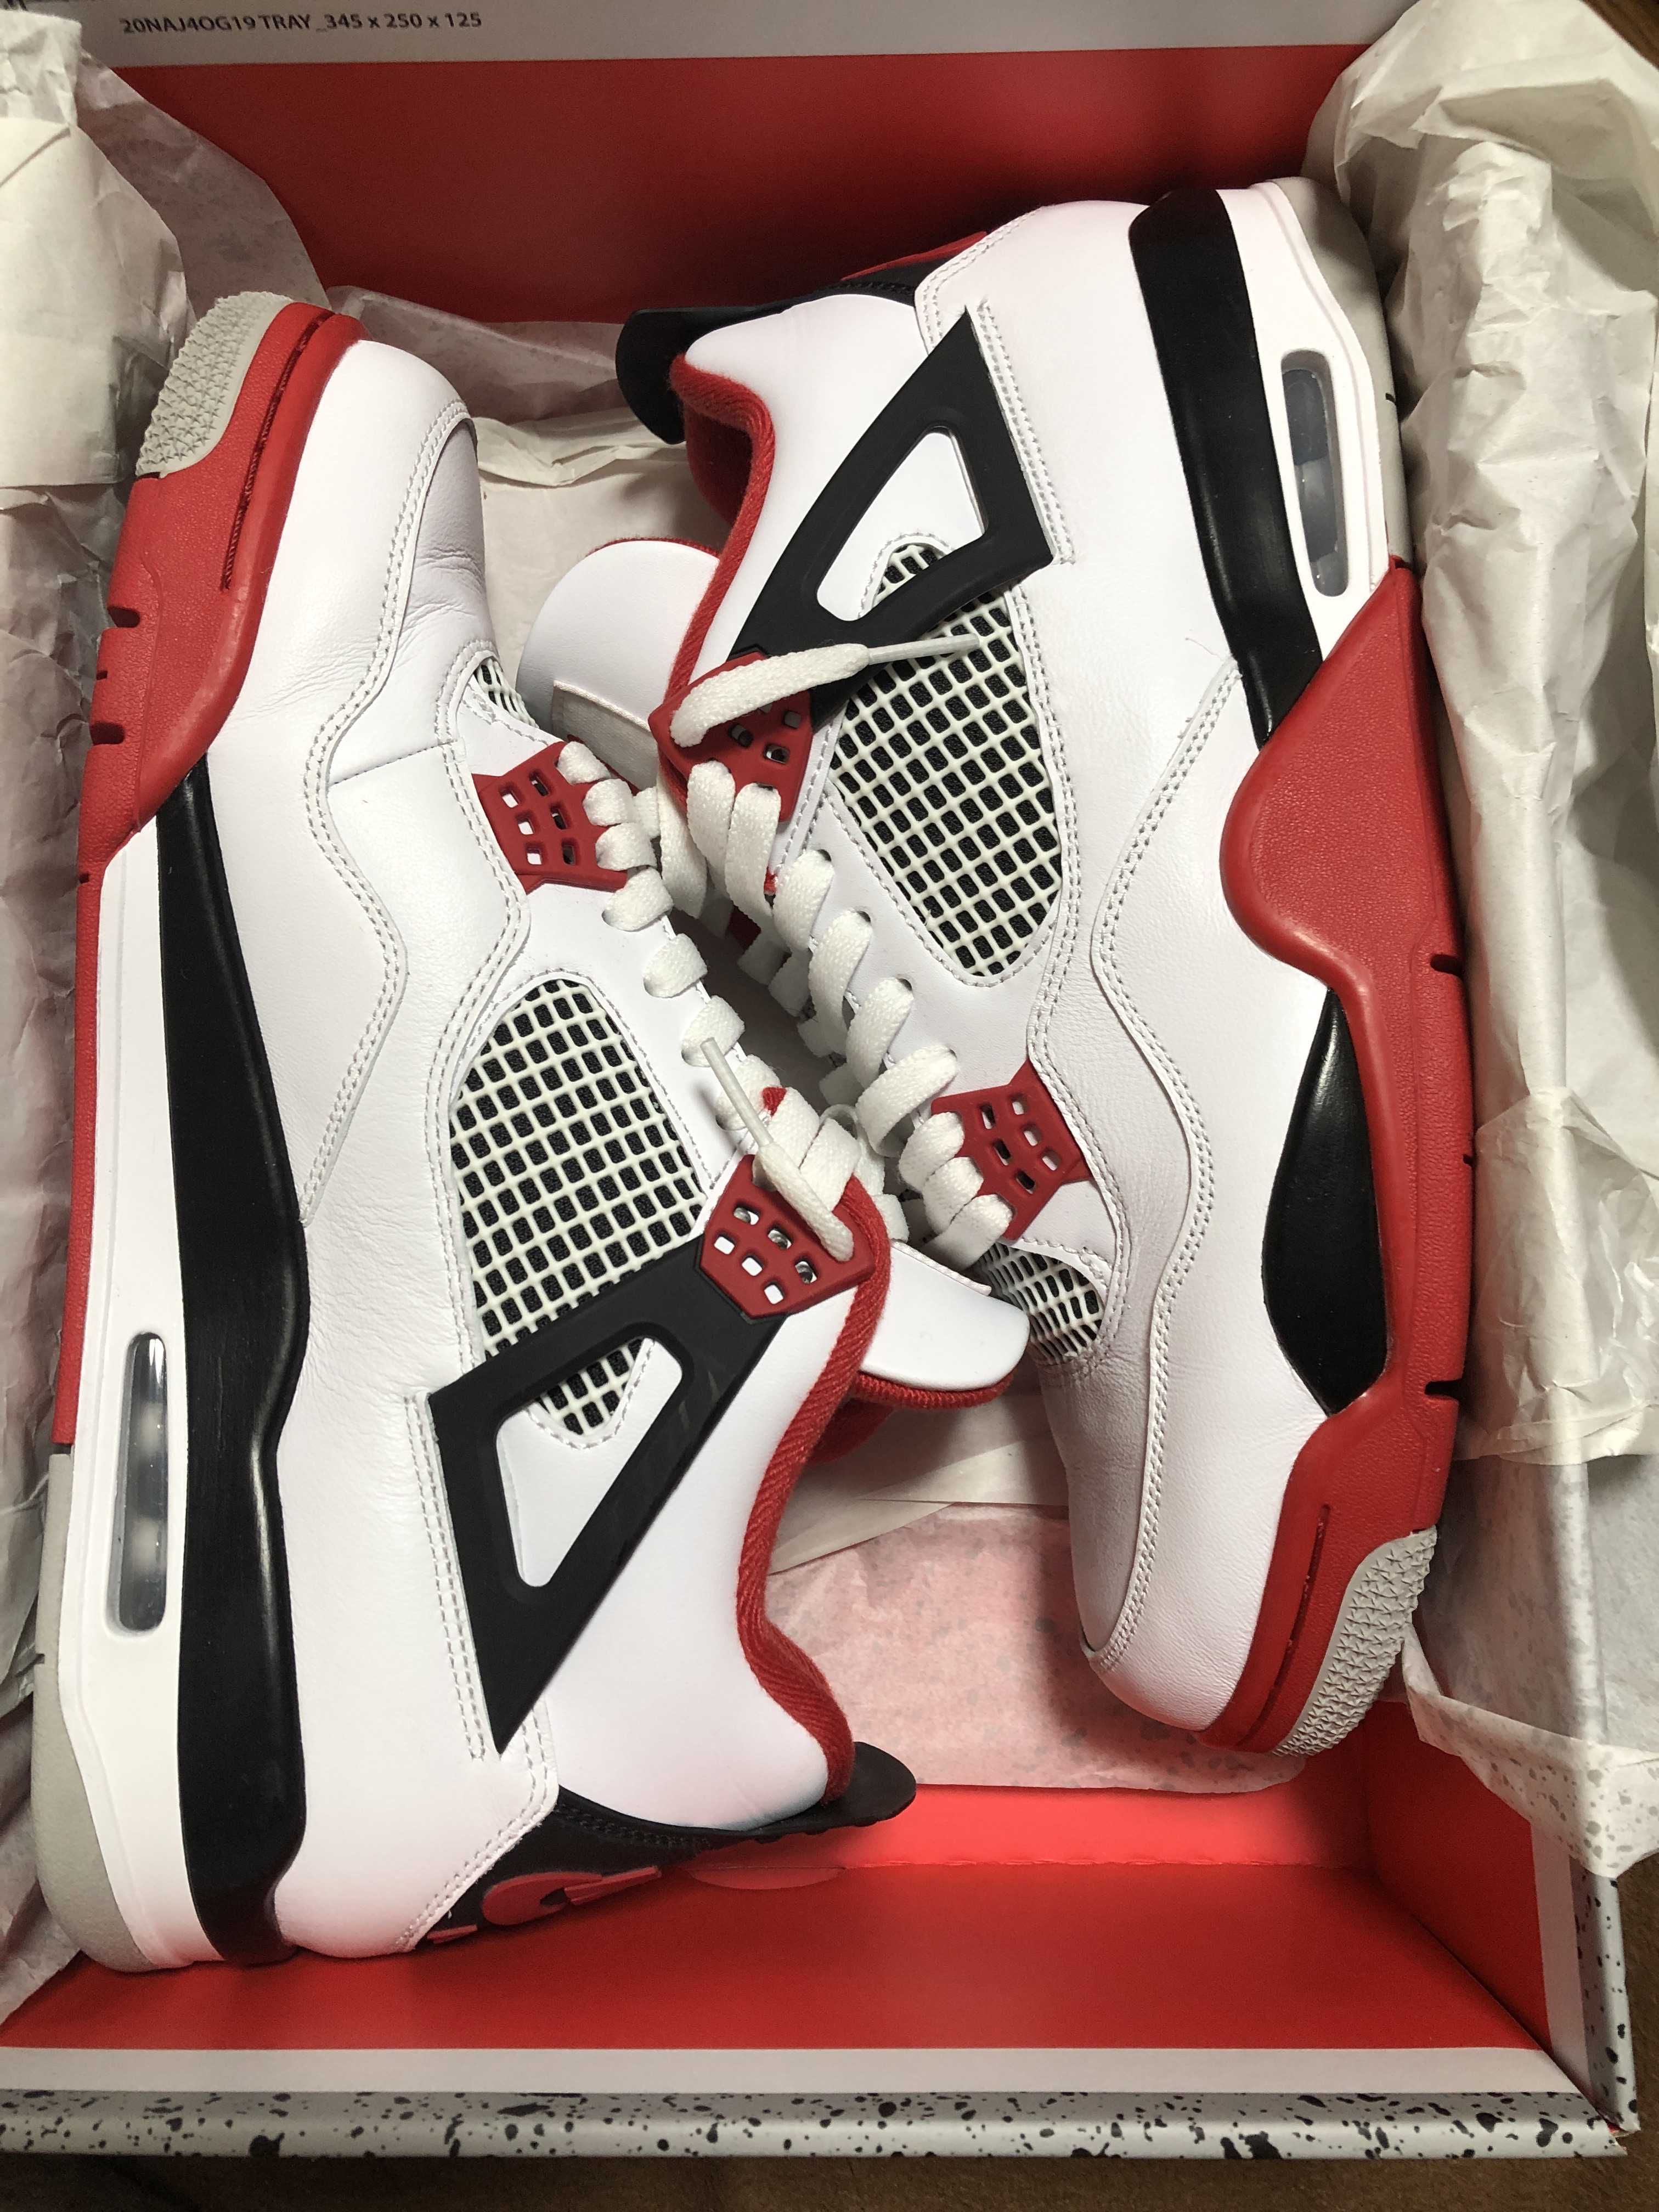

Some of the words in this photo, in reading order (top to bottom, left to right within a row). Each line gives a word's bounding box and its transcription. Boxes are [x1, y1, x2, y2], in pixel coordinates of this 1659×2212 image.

[368, 16, 381, 29] x
[384, 13, 423, 30] 250
[427, 16, 441, 29] x
[444, 12, 482, 28] 125
